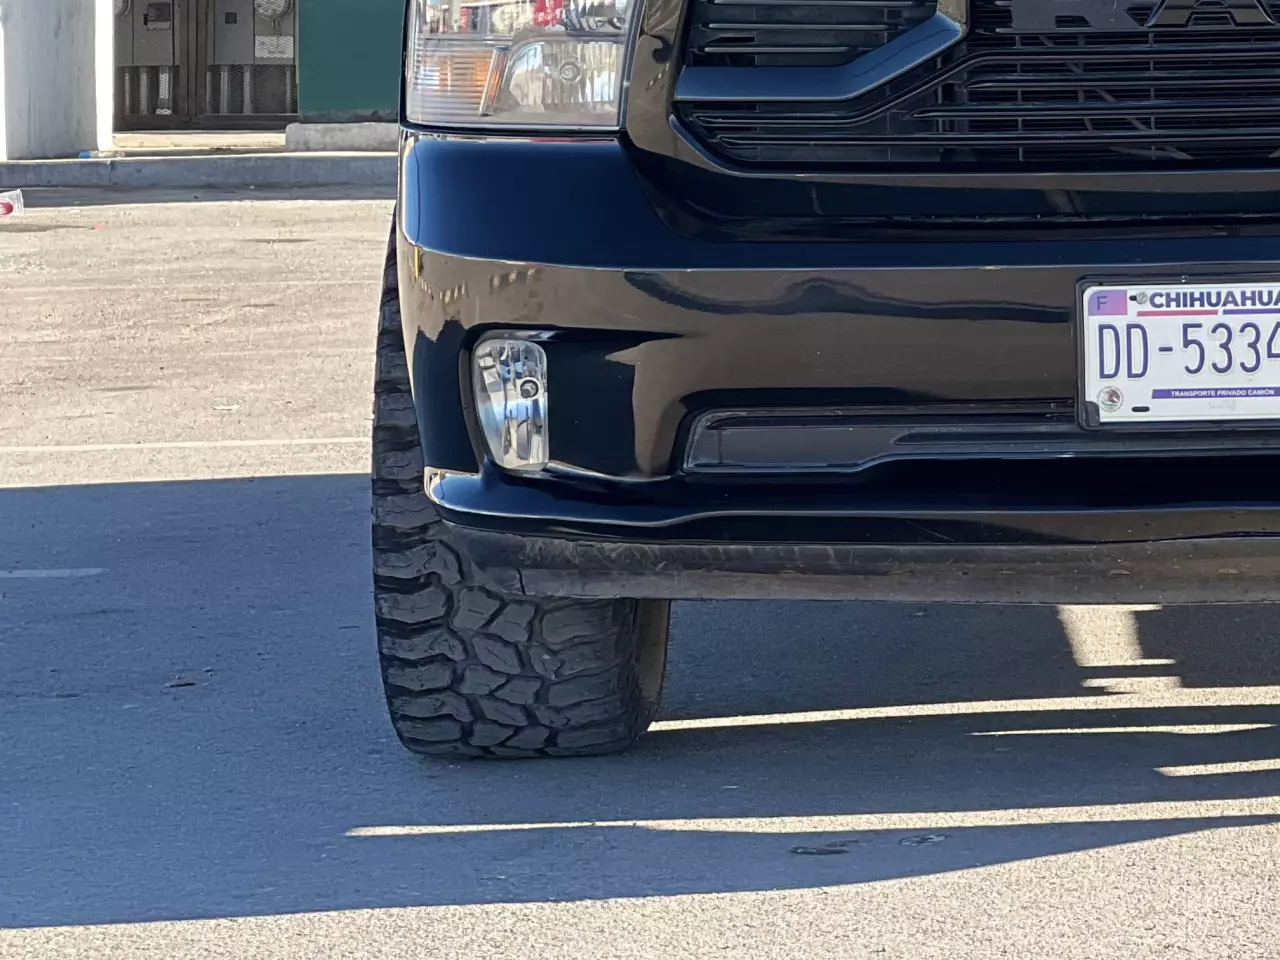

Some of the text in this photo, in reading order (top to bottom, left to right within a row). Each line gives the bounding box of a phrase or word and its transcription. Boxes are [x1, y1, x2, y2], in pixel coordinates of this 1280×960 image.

[1097, 295, 1107, 311] F
[1171, 389, 1215, 397] TRANSPORTE
[1216, 389, 1246, 397] PRIVADO
